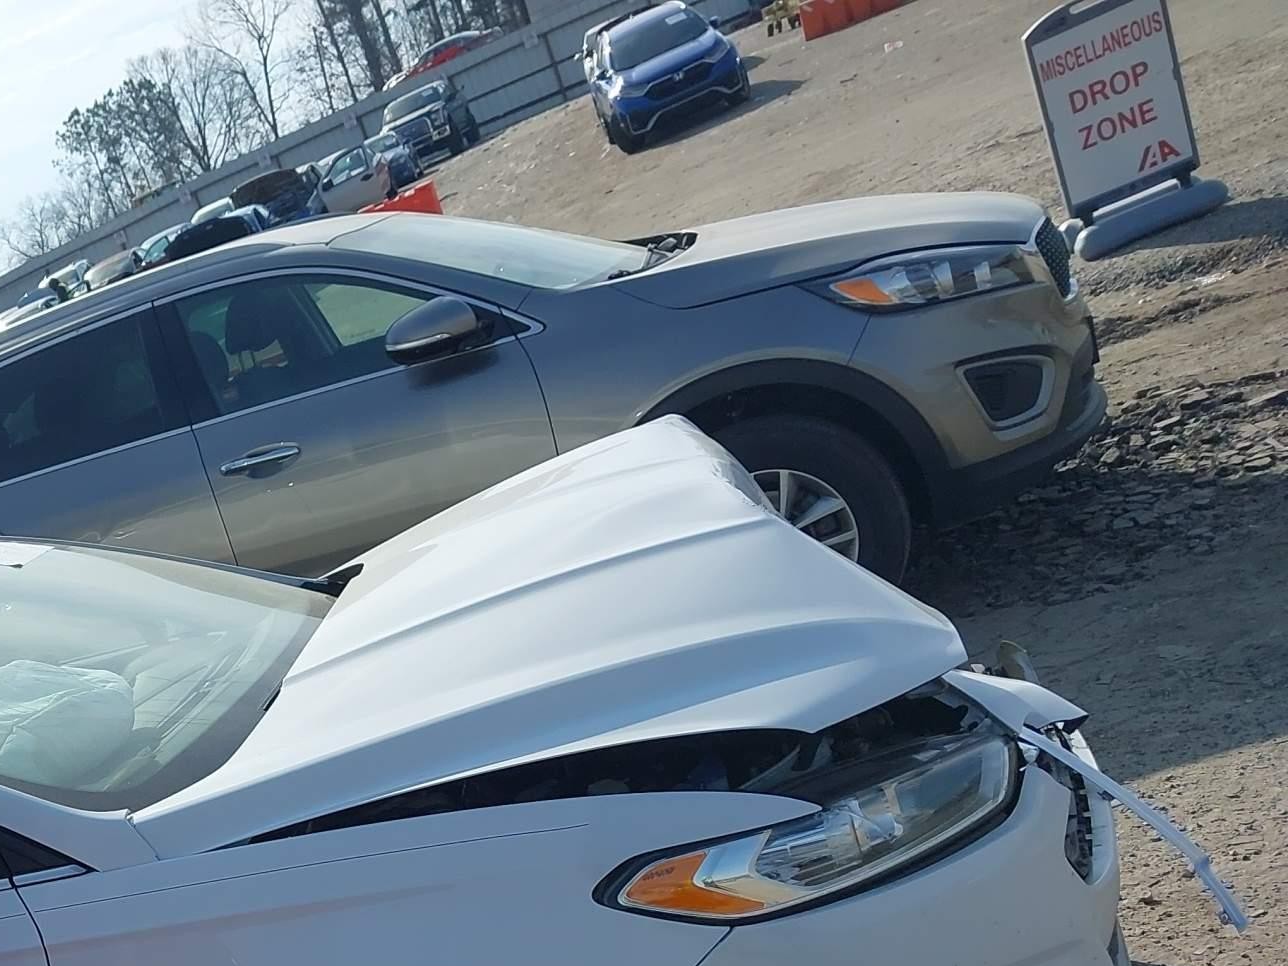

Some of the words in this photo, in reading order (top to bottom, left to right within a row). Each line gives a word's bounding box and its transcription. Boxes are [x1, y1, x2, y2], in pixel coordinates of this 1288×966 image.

[1039, 11, 1163, 82] MISCELLANEOUS
[1068, 61, 1150, 114] DROP
[1078, 98, 1158, 150] ZONE
